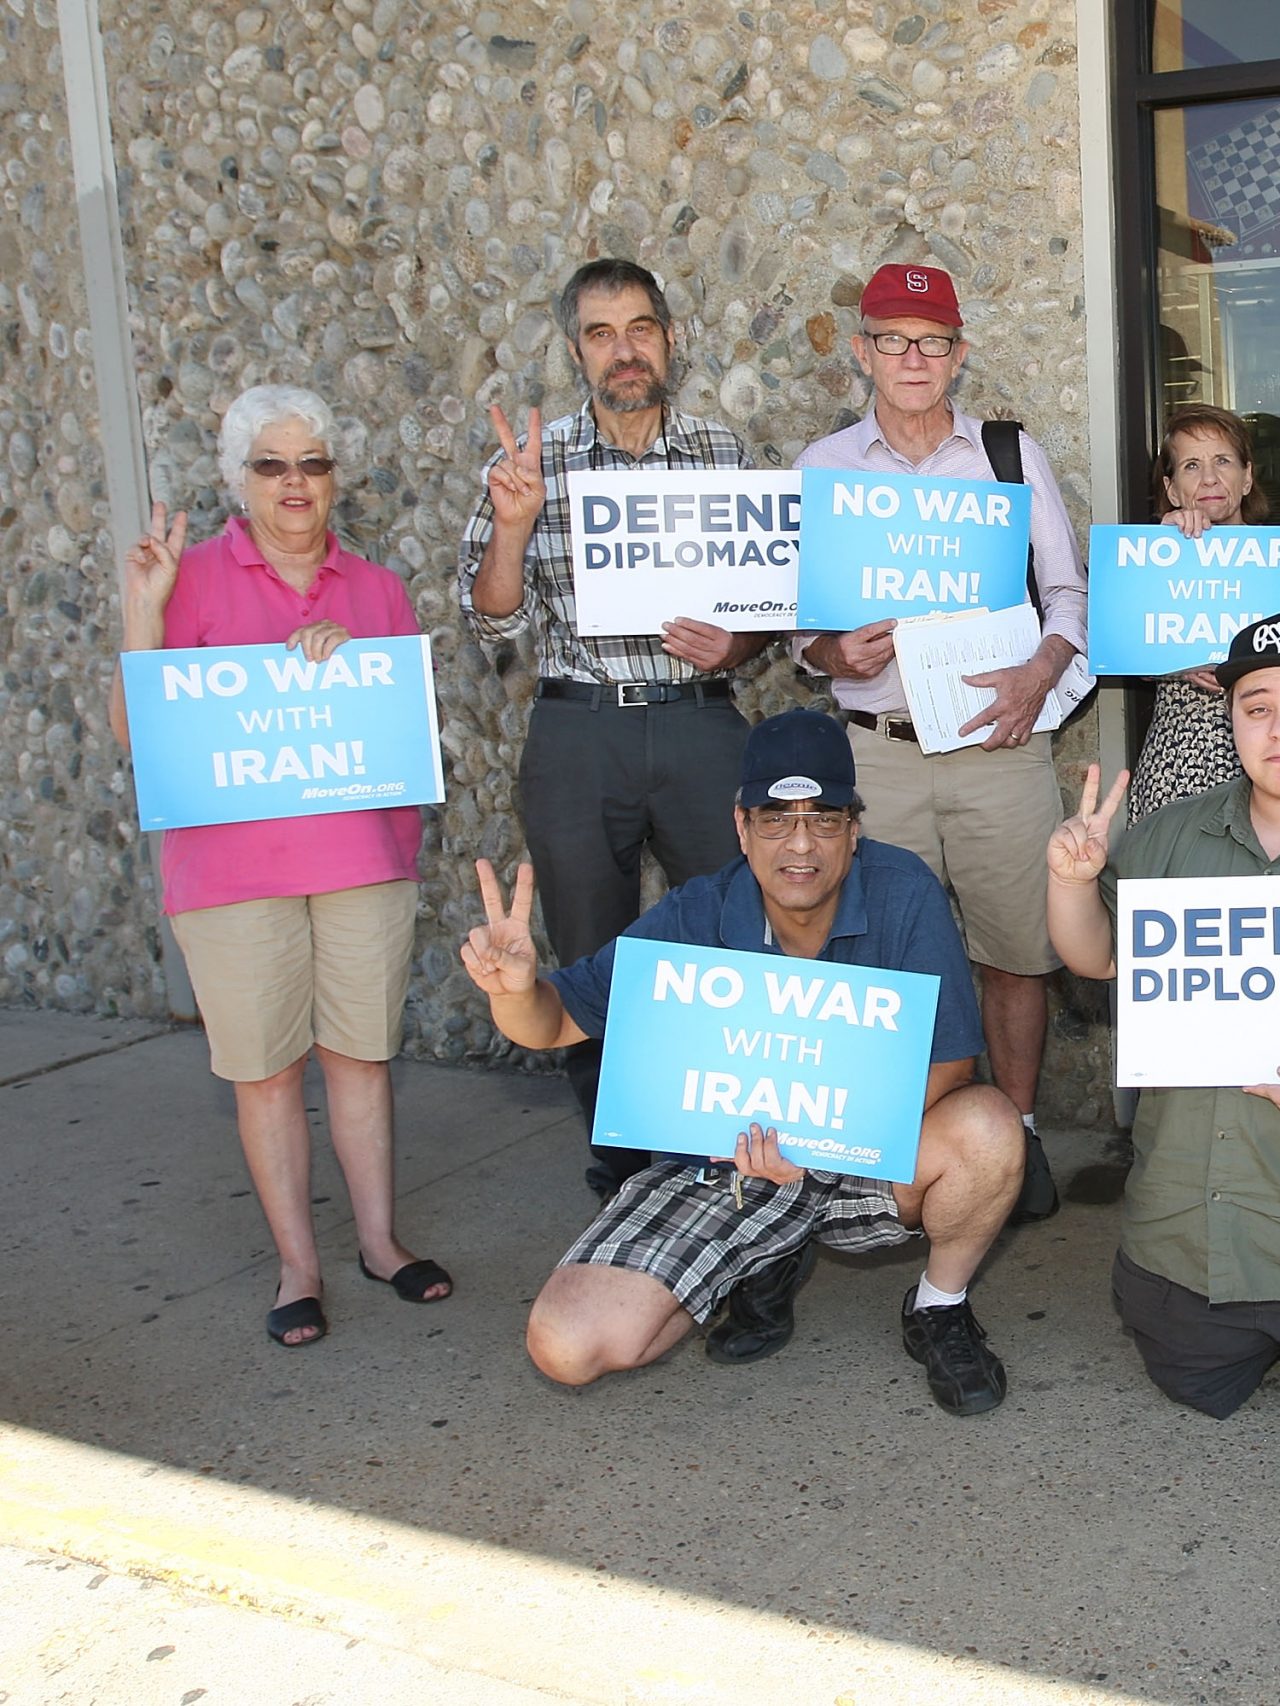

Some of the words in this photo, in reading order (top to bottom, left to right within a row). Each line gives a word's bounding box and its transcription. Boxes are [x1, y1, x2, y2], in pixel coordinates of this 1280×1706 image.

[906, 270, 929, 293] S
[582, 494, 801, 535] DEFEND
[832, 482, 899, 517] NO
[913, 487, 1012, 527] WAR
[886, 531, 961, 558] WITH
[1117, 536, 1180, 567] NO
[861, 566, 981, 604] IRAN!
[1168, 579, 1241, 600] WITH
[1145, 612, 1264, 645] IRAN
[162, 662, 249, 700] NO
[263, 652, 395, 692] WAR
[237, 704, 333, 734] WITH
[213, 741, 367, 787] IRAN!
[653, 959, 744, 1009] NO
[764, 971, 902, 1032] WAR
[722, 1026, 823, 1066] WITH
[682, 1069, 849, 1130] IRAN!
